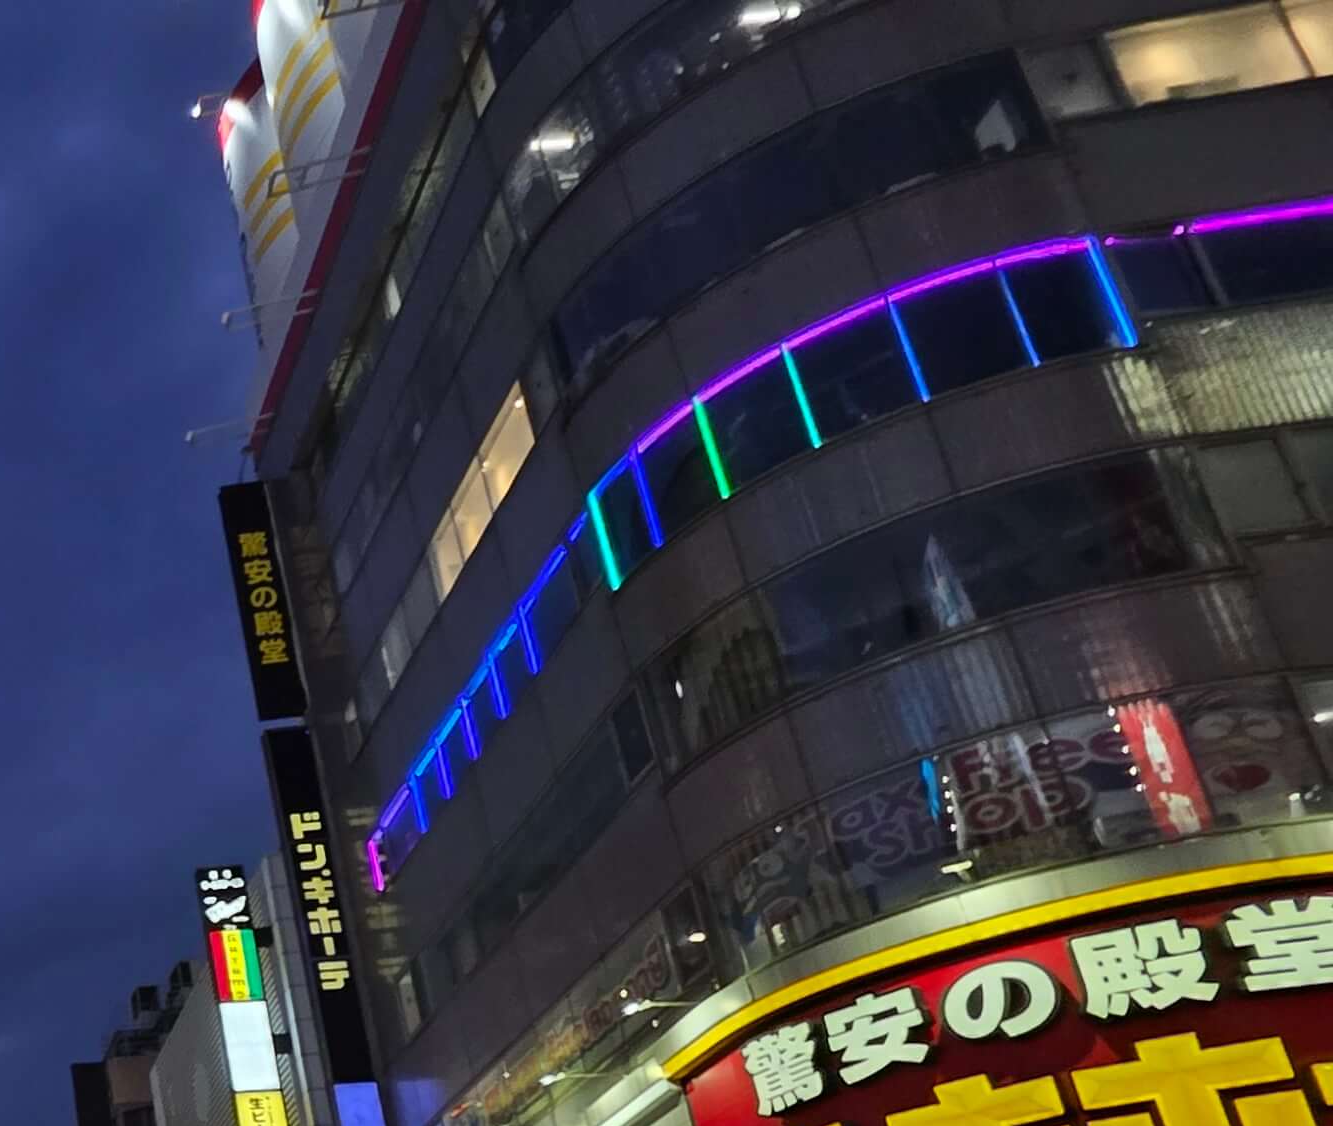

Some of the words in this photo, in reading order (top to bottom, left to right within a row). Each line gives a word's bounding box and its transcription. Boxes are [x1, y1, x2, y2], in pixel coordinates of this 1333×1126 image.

[238, 531, 288, 666] 驚安の殿堂
[741, 893, 1333, 1117] 驚安の殿堂
